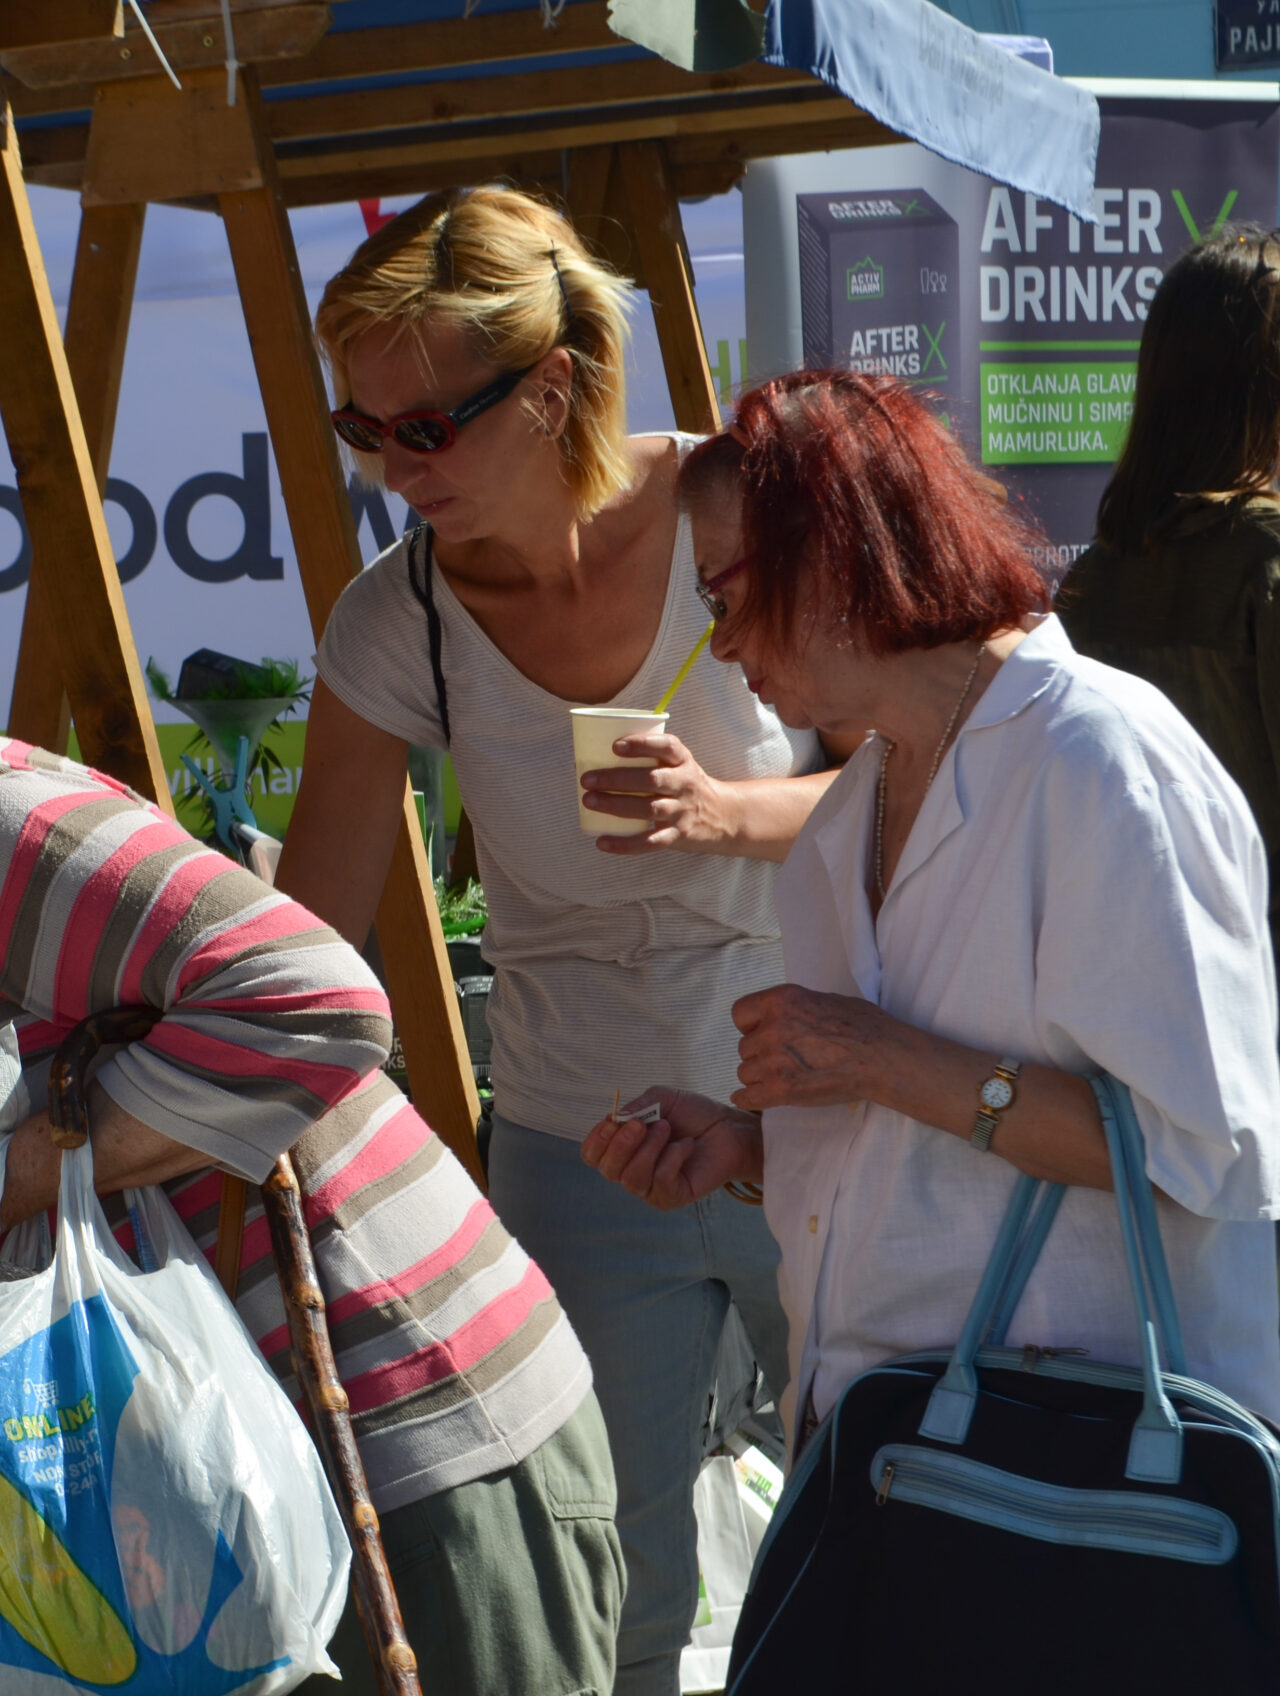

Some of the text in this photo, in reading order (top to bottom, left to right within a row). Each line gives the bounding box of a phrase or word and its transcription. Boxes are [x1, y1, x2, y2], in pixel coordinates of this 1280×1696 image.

[851, 272, 880, 285] ACTIV
[851, 283, 881, 295] PHARM
[980, 265, 1165, 323] DRINKS
[851, 324, 919, 358] AFTER
[987, 373, 1081, 396] OTKLANJA
[988, 397, 1136, 425] MUČNINU I SIMP
[988, 430, 1109, 454] MAMURLUKA.
